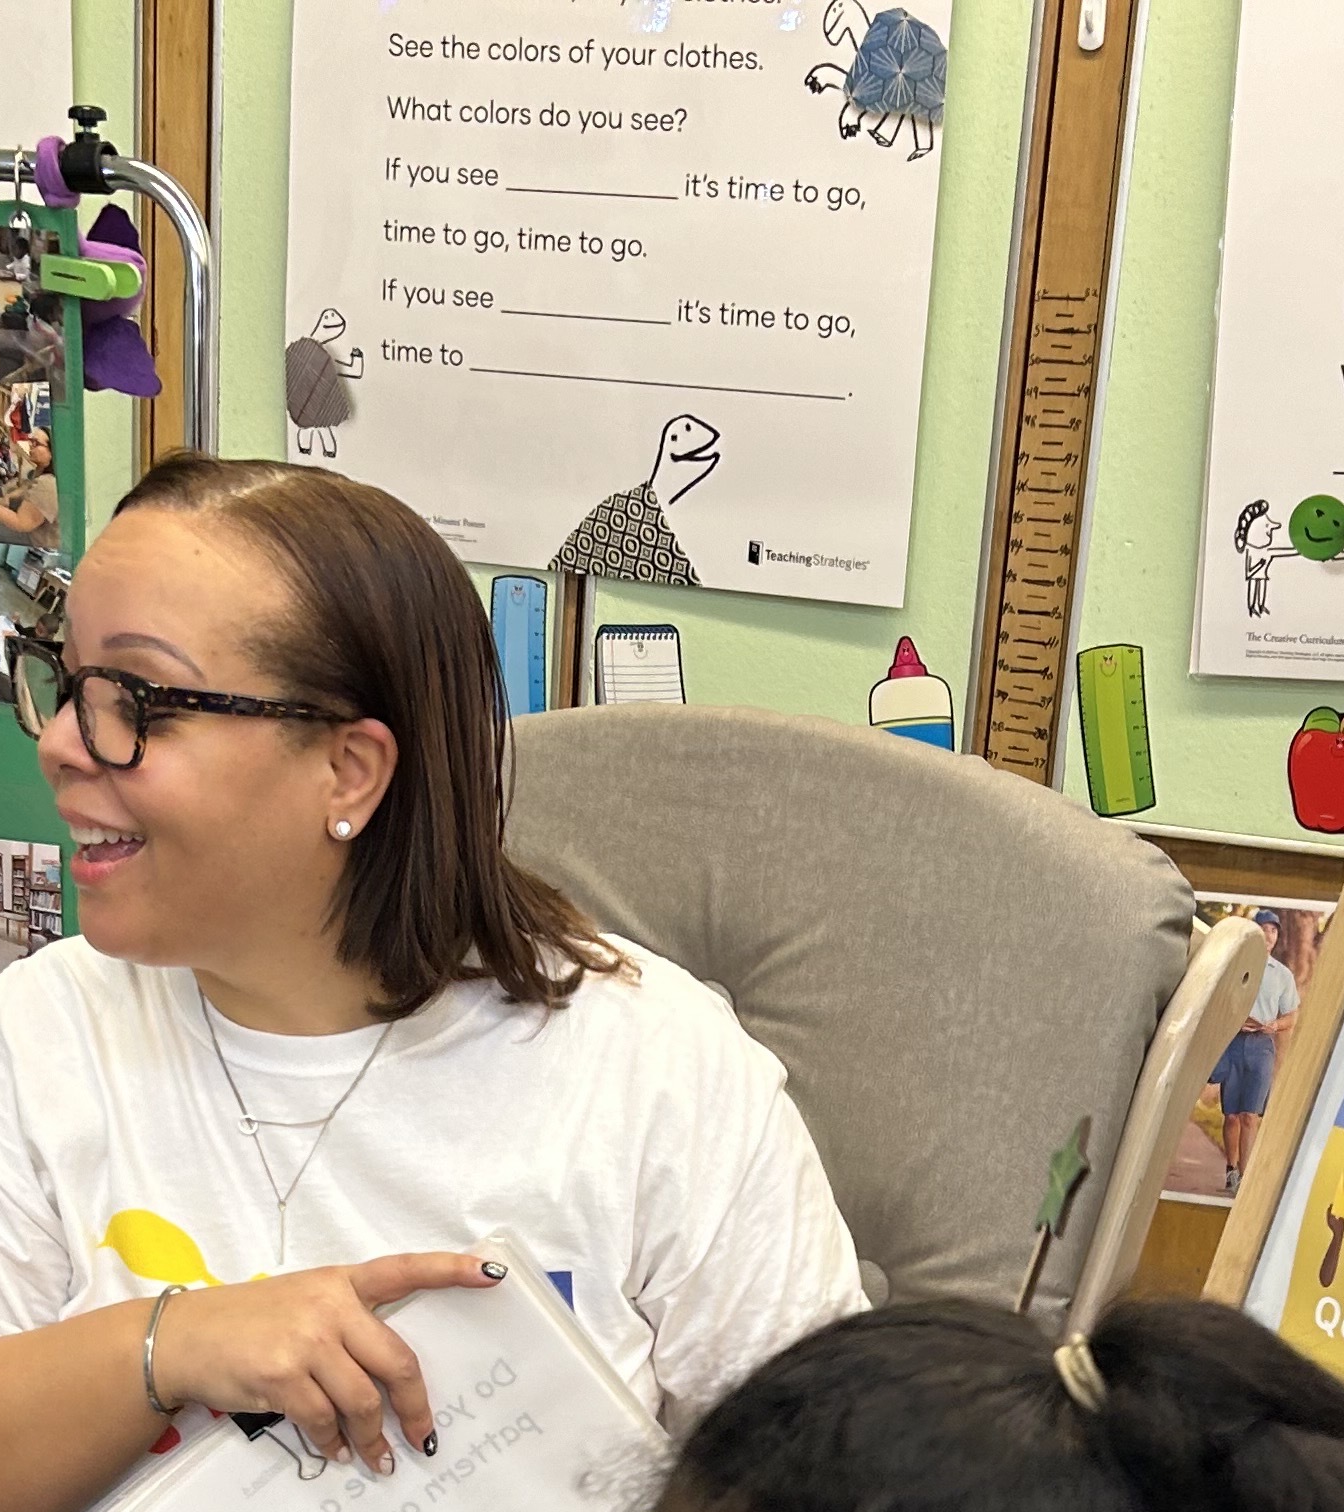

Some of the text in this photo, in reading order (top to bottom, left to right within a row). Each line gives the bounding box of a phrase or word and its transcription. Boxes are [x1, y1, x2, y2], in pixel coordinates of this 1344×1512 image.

[389, 34, 764, 71] See the colors of your clothes.
[387, 97, 687, 133] What colors do you see?
[385, 159, 866, 211] If you see it's time to go,
[383, 220, 646, 261] time to go, time to go.
[1246, 632, 1262, 642] The
[1264, 633, 1297, 643] Creative
